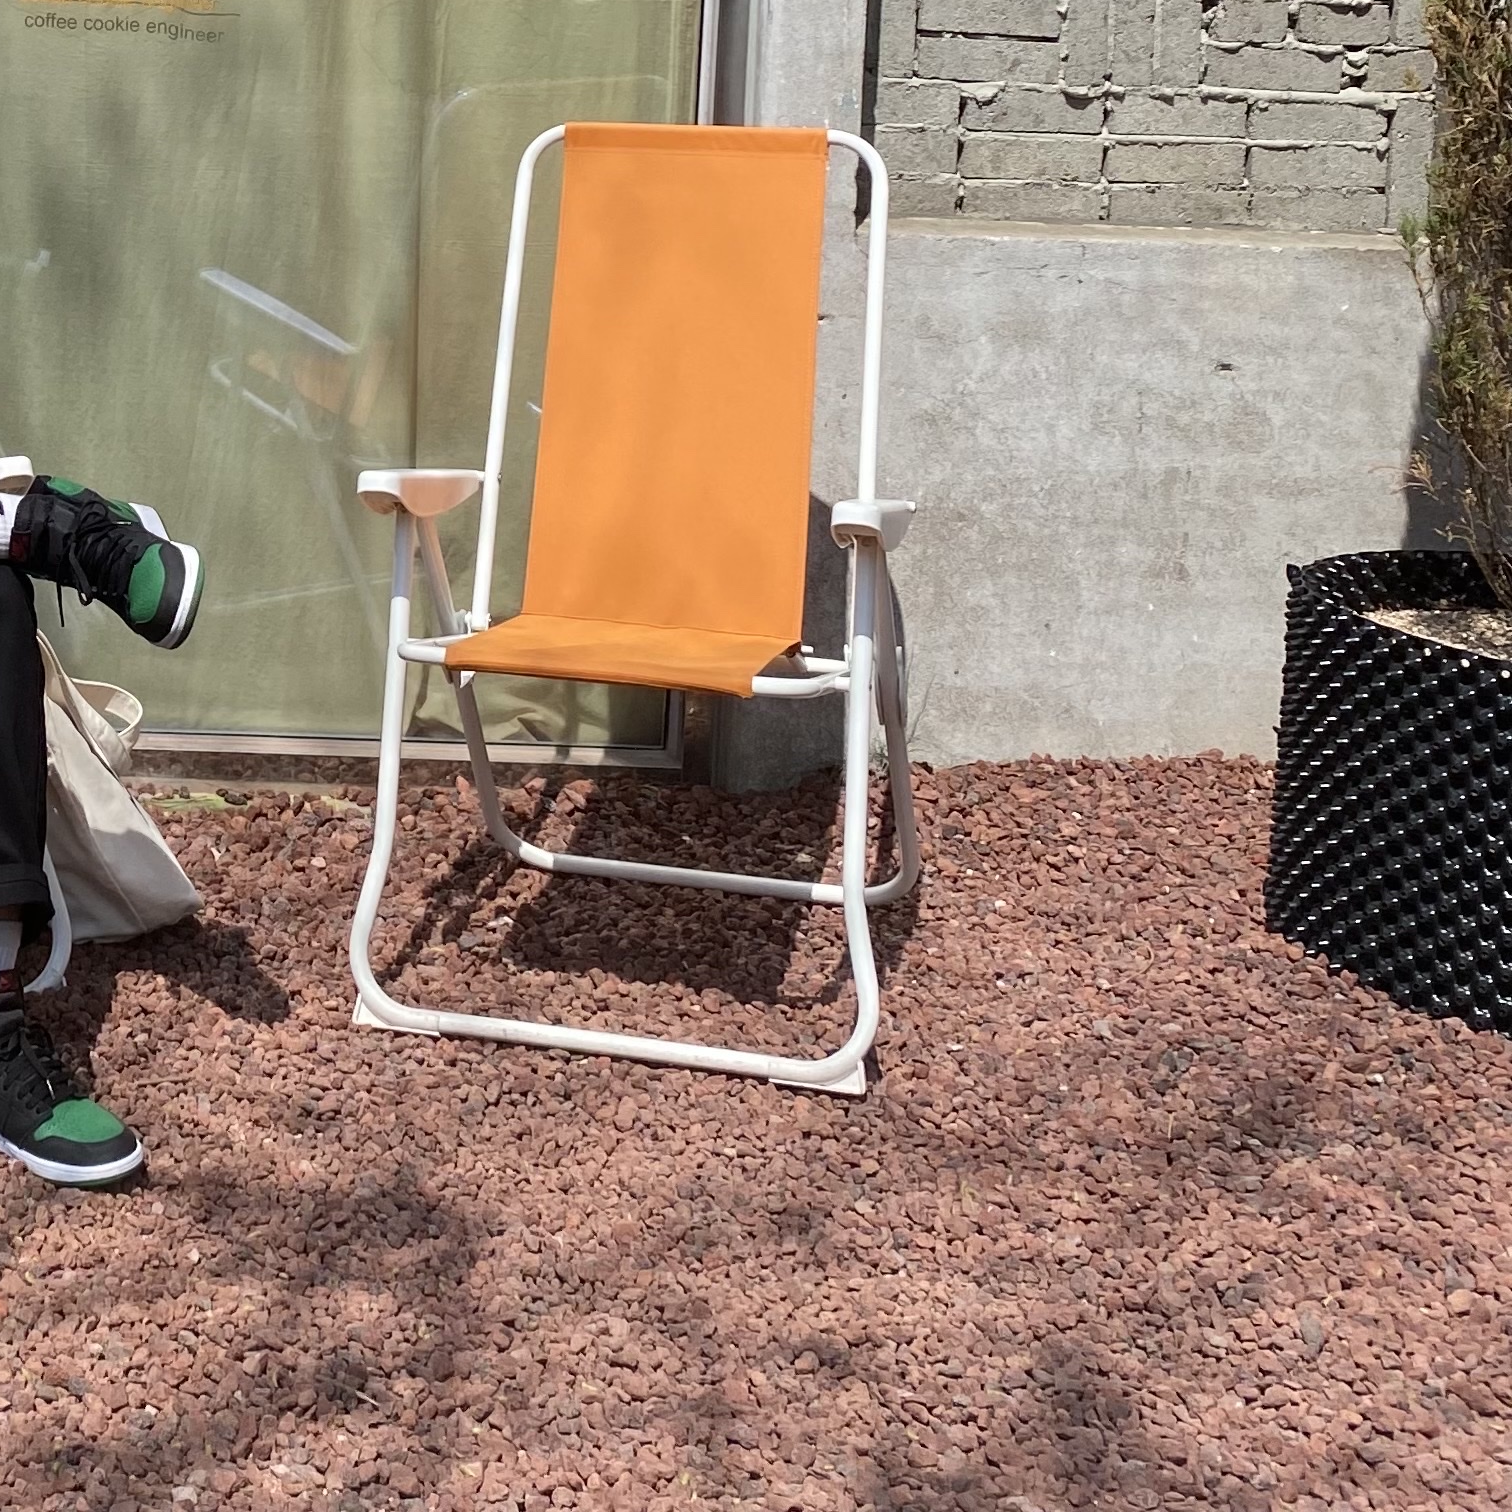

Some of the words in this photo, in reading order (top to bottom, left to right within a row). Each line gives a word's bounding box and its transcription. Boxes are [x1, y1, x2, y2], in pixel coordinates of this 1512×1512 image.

[24, 12, 78, 30] coffee
[83, 15, 140, 33] cookie
[146, 20, 224, 43] engineer
